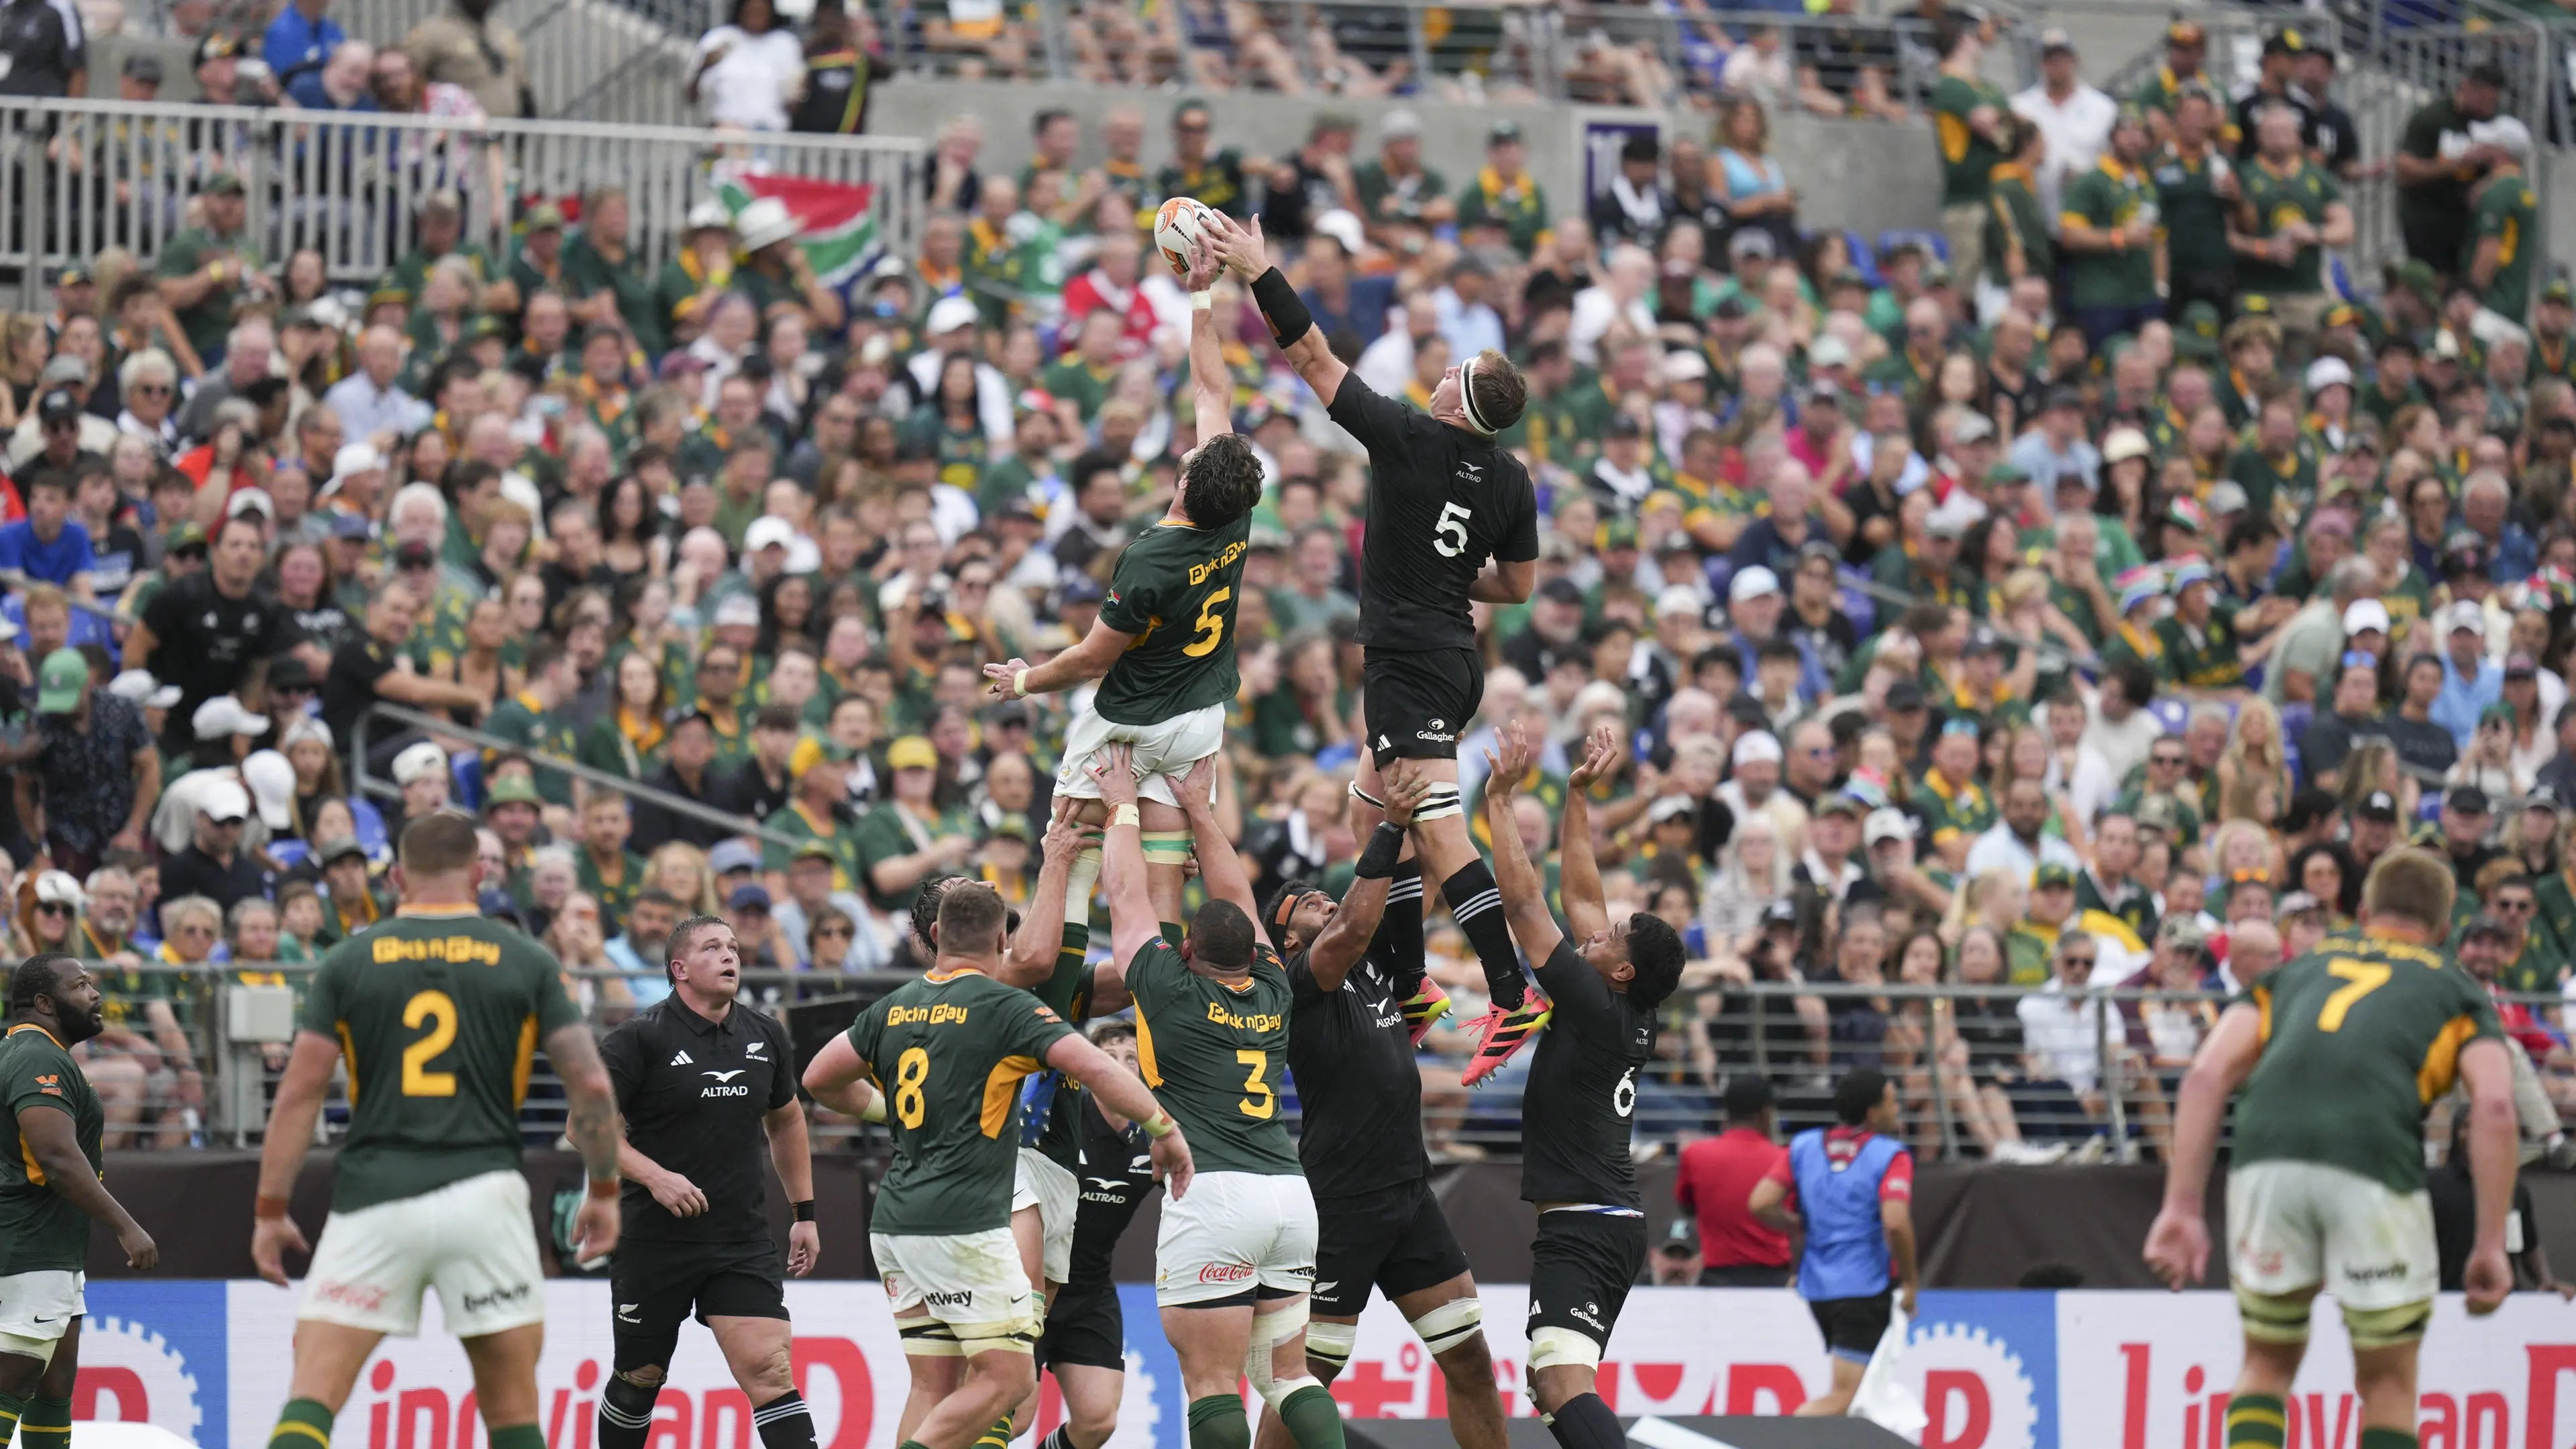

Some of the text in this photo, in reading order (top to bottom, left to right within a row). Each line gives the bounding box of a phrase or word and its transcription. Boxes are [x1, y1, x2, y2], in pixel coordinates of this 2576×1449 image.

[1456, 470, 1481, 483] ALTRAD
[1433, 501, 1472, 557] 5
[1182, 585, 1230, 657] 5
[1416, 731, 1455, 743] Gallagher
[929, 1003, 968, 1024] Pay
[2317, 957, 2392, 1033] 7
[1208, 1002, 1238, 1029] Pick
[1254, 1014, 1281, 1033] Pay
[401, 989, 458, 1097] 2
[700, 1085, 748, 1097] ALTRAD
[895, 1046, 930, 1130] 8
[1236, 1049, 1275, 1120] 3
[1613, 1067, 1636, 1118] 6
[1079, 1191, 1126, 1204] ALTRAD
[1570, 1307, 1605, 1332] Gallagher
